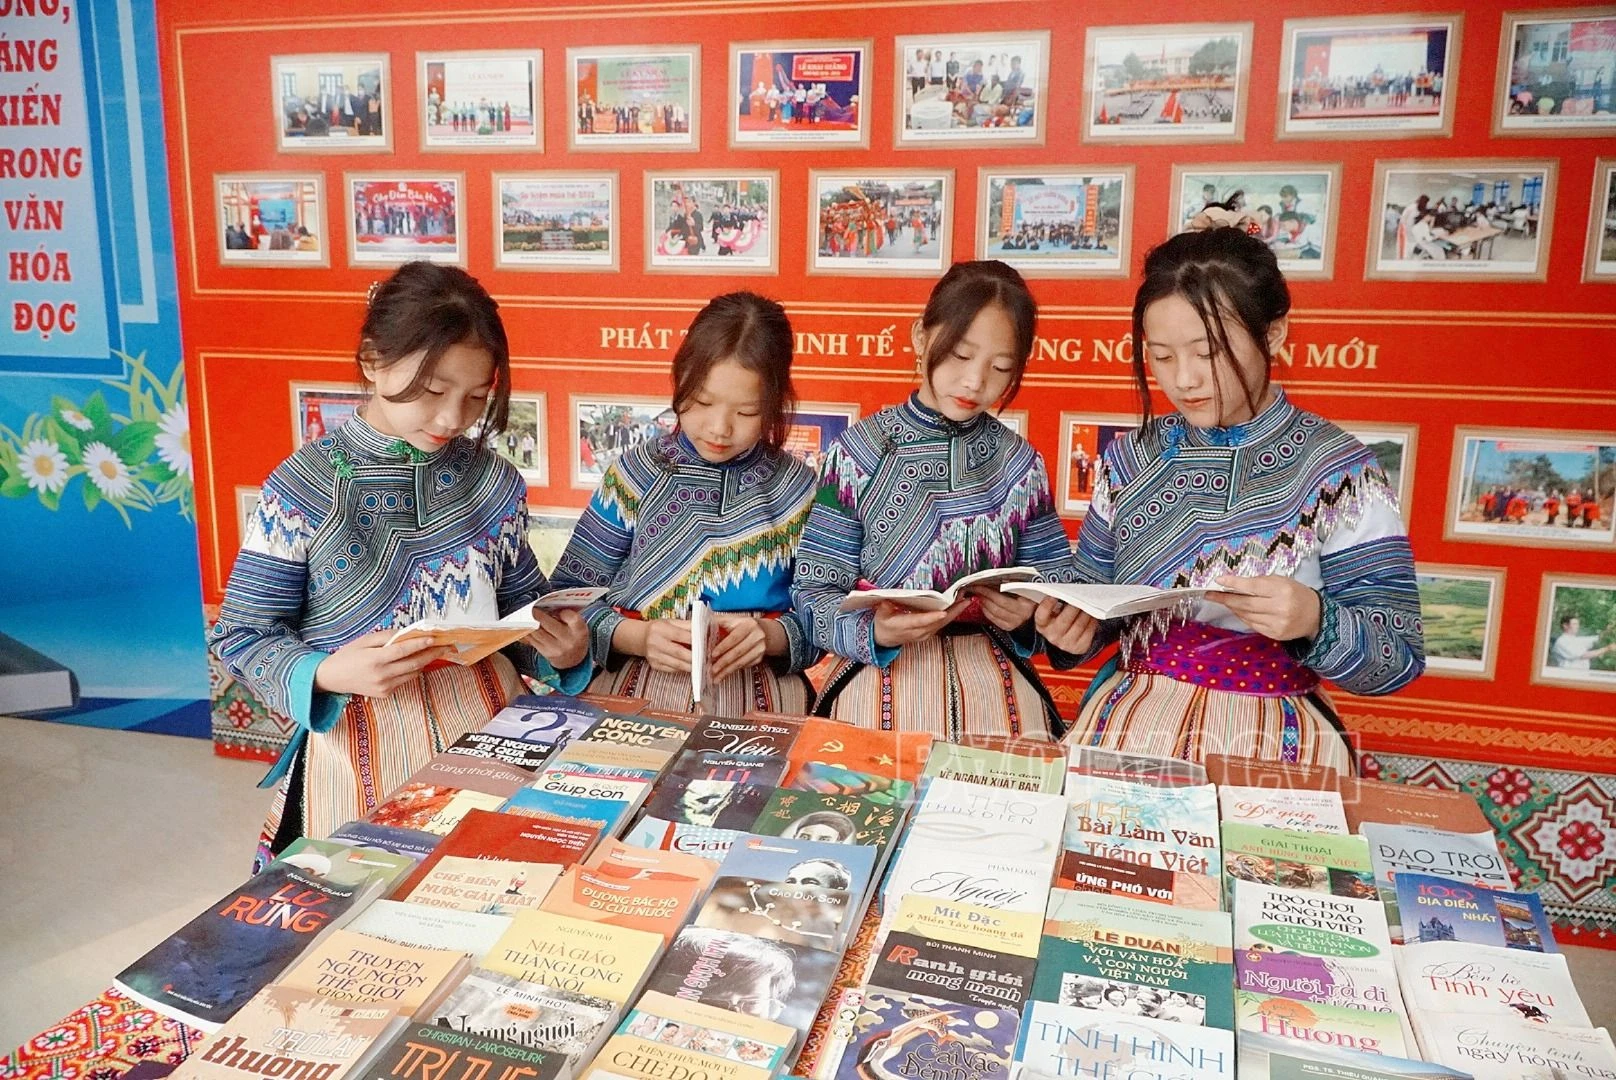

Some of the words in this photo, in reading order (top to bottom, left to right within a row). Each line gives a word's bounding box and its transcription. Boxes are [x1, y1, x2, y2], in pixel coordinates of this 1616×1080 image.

[5, 194, 63, 230] VĂN
[9, 246, 71, 281] HÓA
[14, 303, 76, 339] ĐỌC
[600, 321, 673, 349] PHÁT
[856, 324, 897, 357] TẾ
[1304, 336, 1380, 369] MỚI
[708, 720, 757, 732] DANIELLE
[759, 724, 789, 735] STEEL
[544, 781, 587, 795] Giúp
[589, 788, 624, 799] con
[1078, 816, 1112, 836] Bài
[1118, 823, 1165, 843] Làm
[1171, 830, 1215, 849] Văn
[769, 887, 793, 898] CAO
[793, 891, 815, 902] DUY
[1076, 872, 1108, 887] ỨNG
[1111, 880, 1143, 895] PHÓ
[1146, 886, 1173, 900] VỚI
[1307, 898, 1355, 913] CHƠI
[349, 948, 424, 975] TRUYỆN
[886, 944, 965, 976] Ranh
[942, 944, 971, 954] THANH
[973, 950, 997, 959] MINH
[1119, 950, 1149, 963] VĂN
[568, 963, 623, 984] LONG
[1097, 967, 1133, 980] VIỆT
[1135, 973, 1170, 987] NAM
[1105, 959, 1137, 972] CON
[1140, 964, 1189, 980] NGƯỜI
[514, 989, 544, 1004] MINH
[906, 969, 963, 991] mong
[965, 980, 1022, 1003] manh
[1244, 969, 1324, 994] Người
[1327, 983, 1357, 999] ra
[1363, 985, 1389, 1003] đi
[1422, 975, 1489, 998] Tình
[1497, 987, 1555, 1007] yêu
[1034, 1020, 1118, 1053] TÌNH
[1131, 1034, 1224, 1073] HÌNH
[1259, 1013, 1383, 1056] Hương
[1456, 1045, 1509, 1064] ngày
[1517, 1051, 1570, 1071] hôm
[1575, 1064, 1616, 1080] qua
